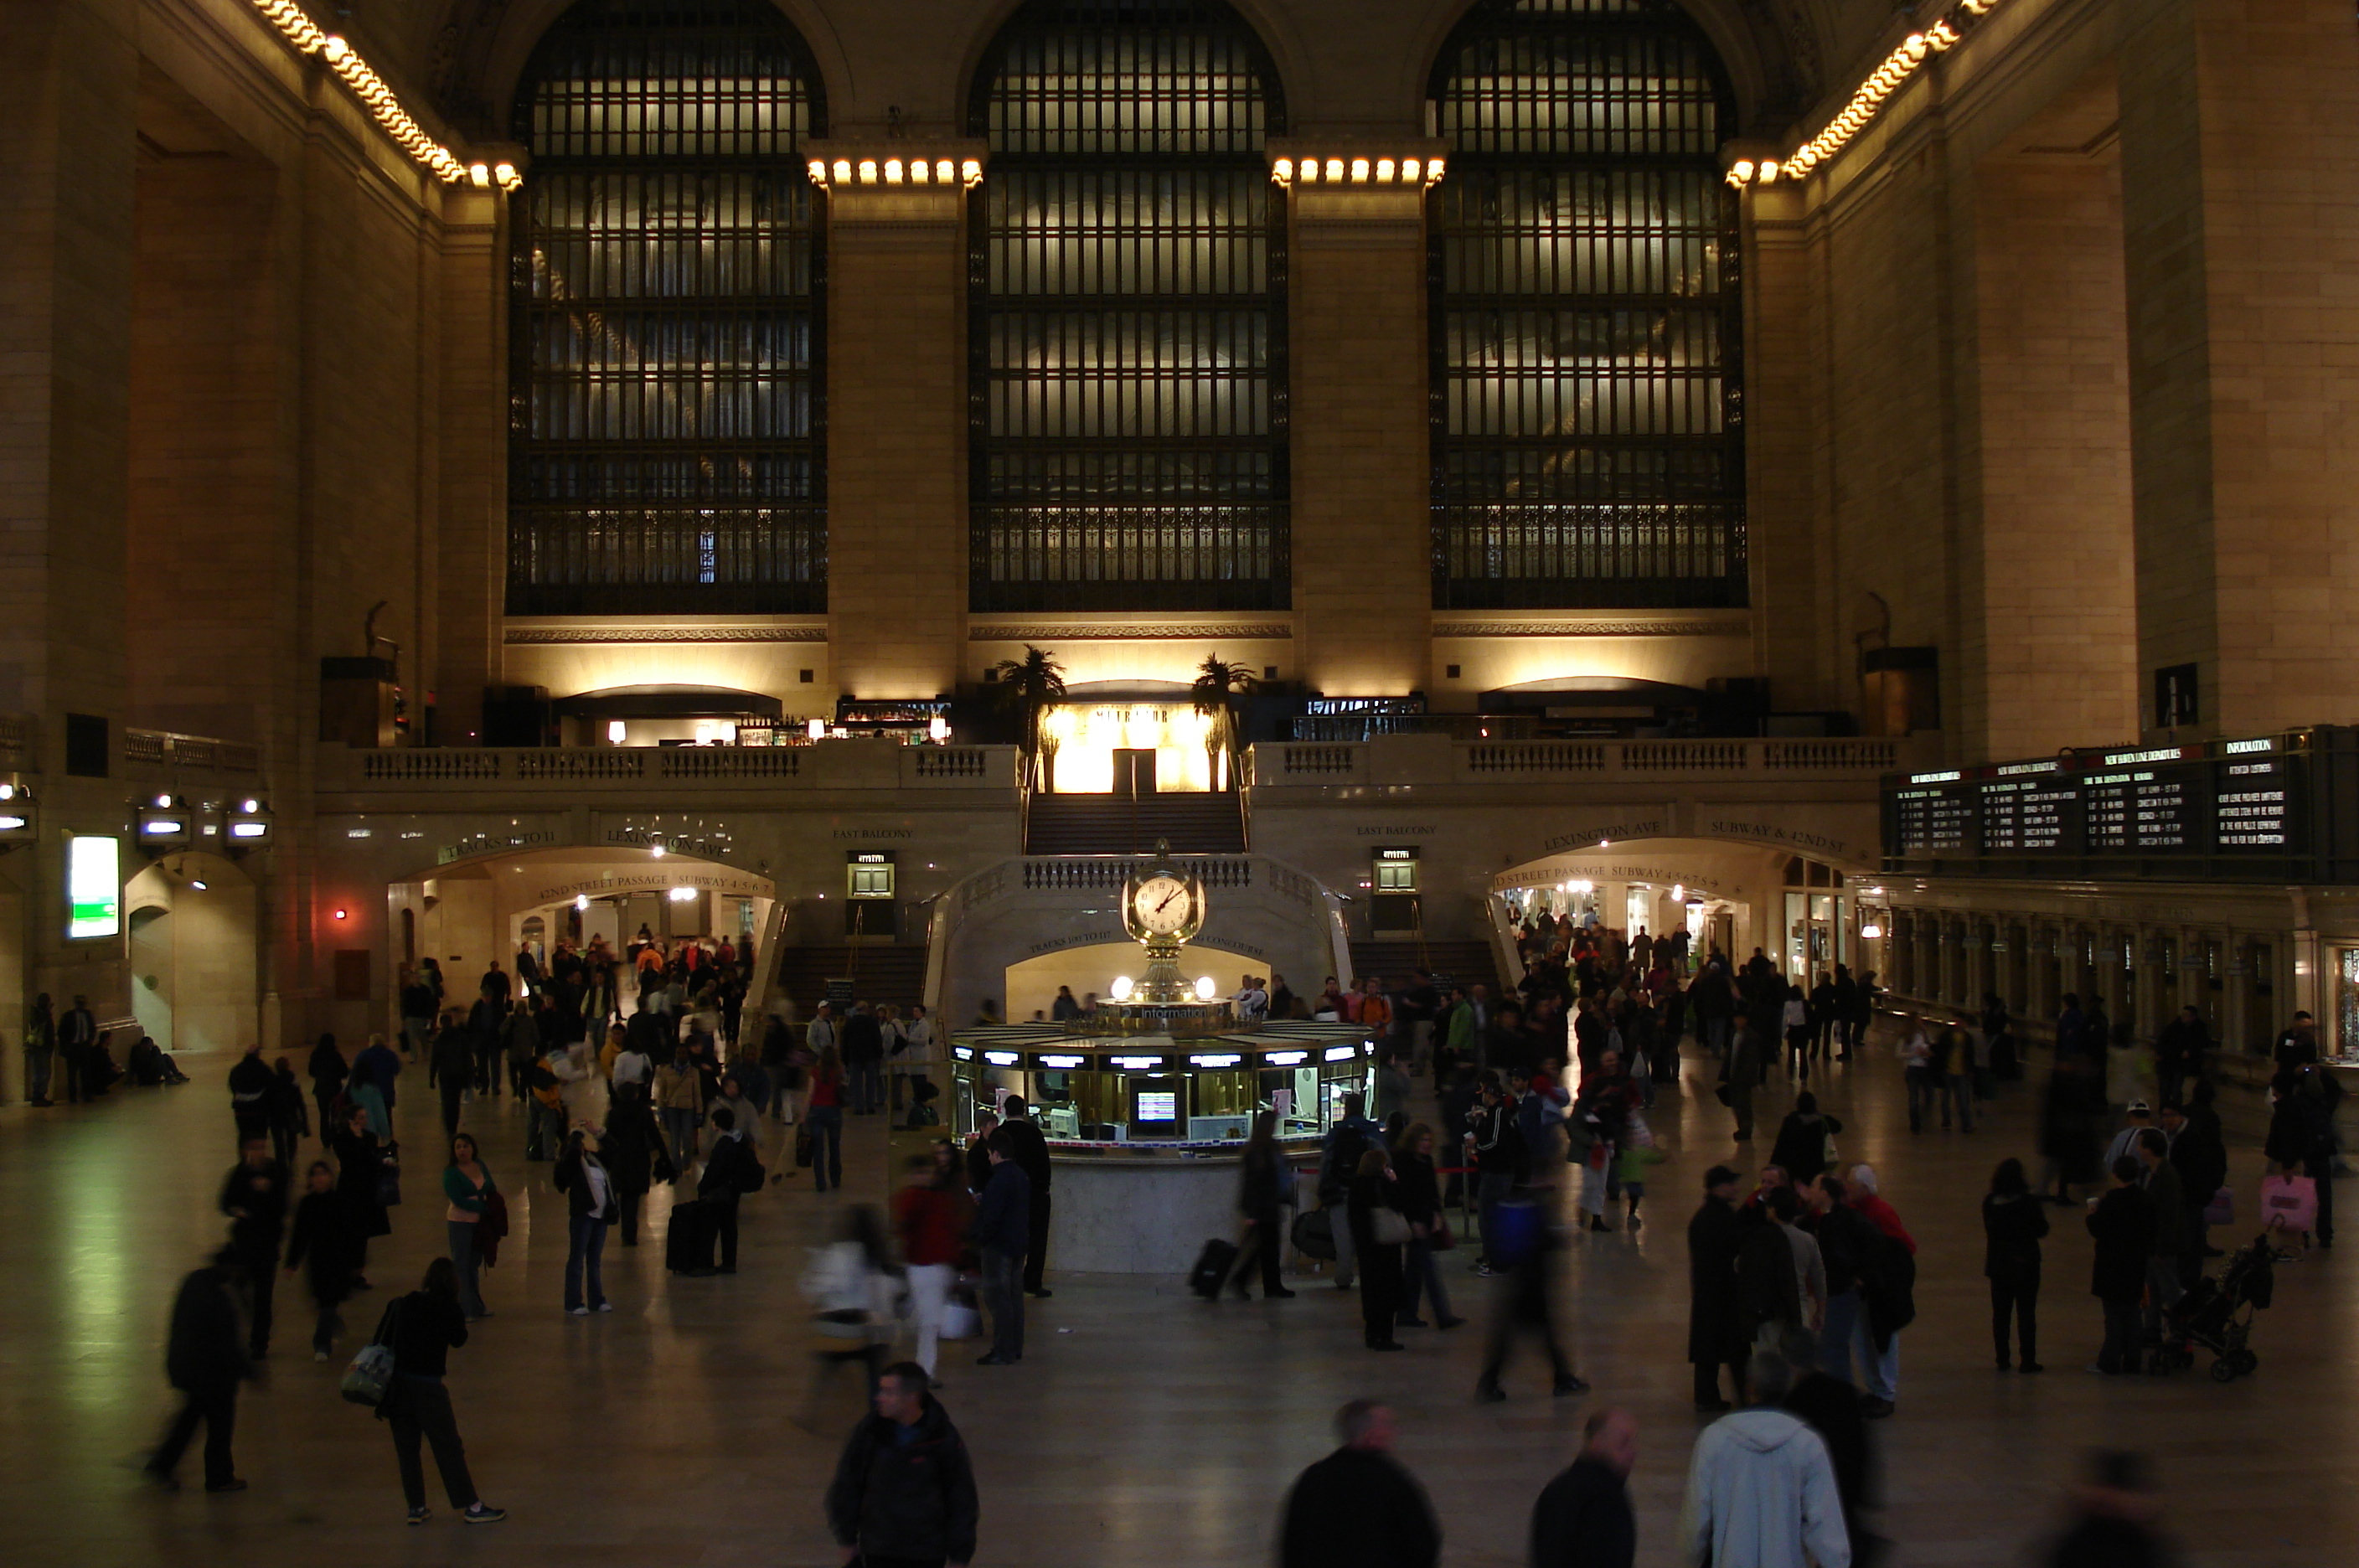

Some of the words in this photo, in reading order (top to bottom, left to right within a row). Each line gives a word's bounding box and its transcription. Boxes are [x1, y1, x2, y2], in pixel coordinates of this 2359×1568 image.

[2227, 739, 2271, 754] INFORMATION
[834, 830, 859, 838] EAST
[863, 830, 914, 838] BALCONY
[1357, 826, 1382, 835] EAST
[1386, 825, 1437, 835] BALCONY
[1545, 823, 1629, 851] LEXINGTON
[1634, 821, 1660, 835] AVE
[1711, 820, 1772, 837] SUBWAY
[1774, 828, 1787, 840] &
[1791, 831, 1825, 848] 42ND
[1829, 839, 1847, 853] ST
[447, 838, 501, 858] TRACKS
[520, 832, 541, 844] TO
[607, 830, 693, 850] LEXINGTON
[697, 843, 725, 857] AVE
[1508, 869, 1551, 885] STREET
[1554, 866, 1607, 879] PASSAGE
[1612, 866, 1664, 879] SUBWAY
[539, 885, 570, 900] 42ND
[572, 878, 613, 892] STREET
[618, 874, 668, 887] PASSAGE
[679, 876, 726, 888] SUBWAY
[1149, 885, 1154, 893] 11
[1159, 881, 1165, 890] 12
[1180, 901, 1185, 910] 3
[1169, 920, 1175, 928] 5
[1030, 937, 1066, 953] TRACKS
[1083, 932, 1097, 941] TO
[1206, 936, 1264, 956] CONCOURSE
[1141, 1006, 1207, 1019] Information
